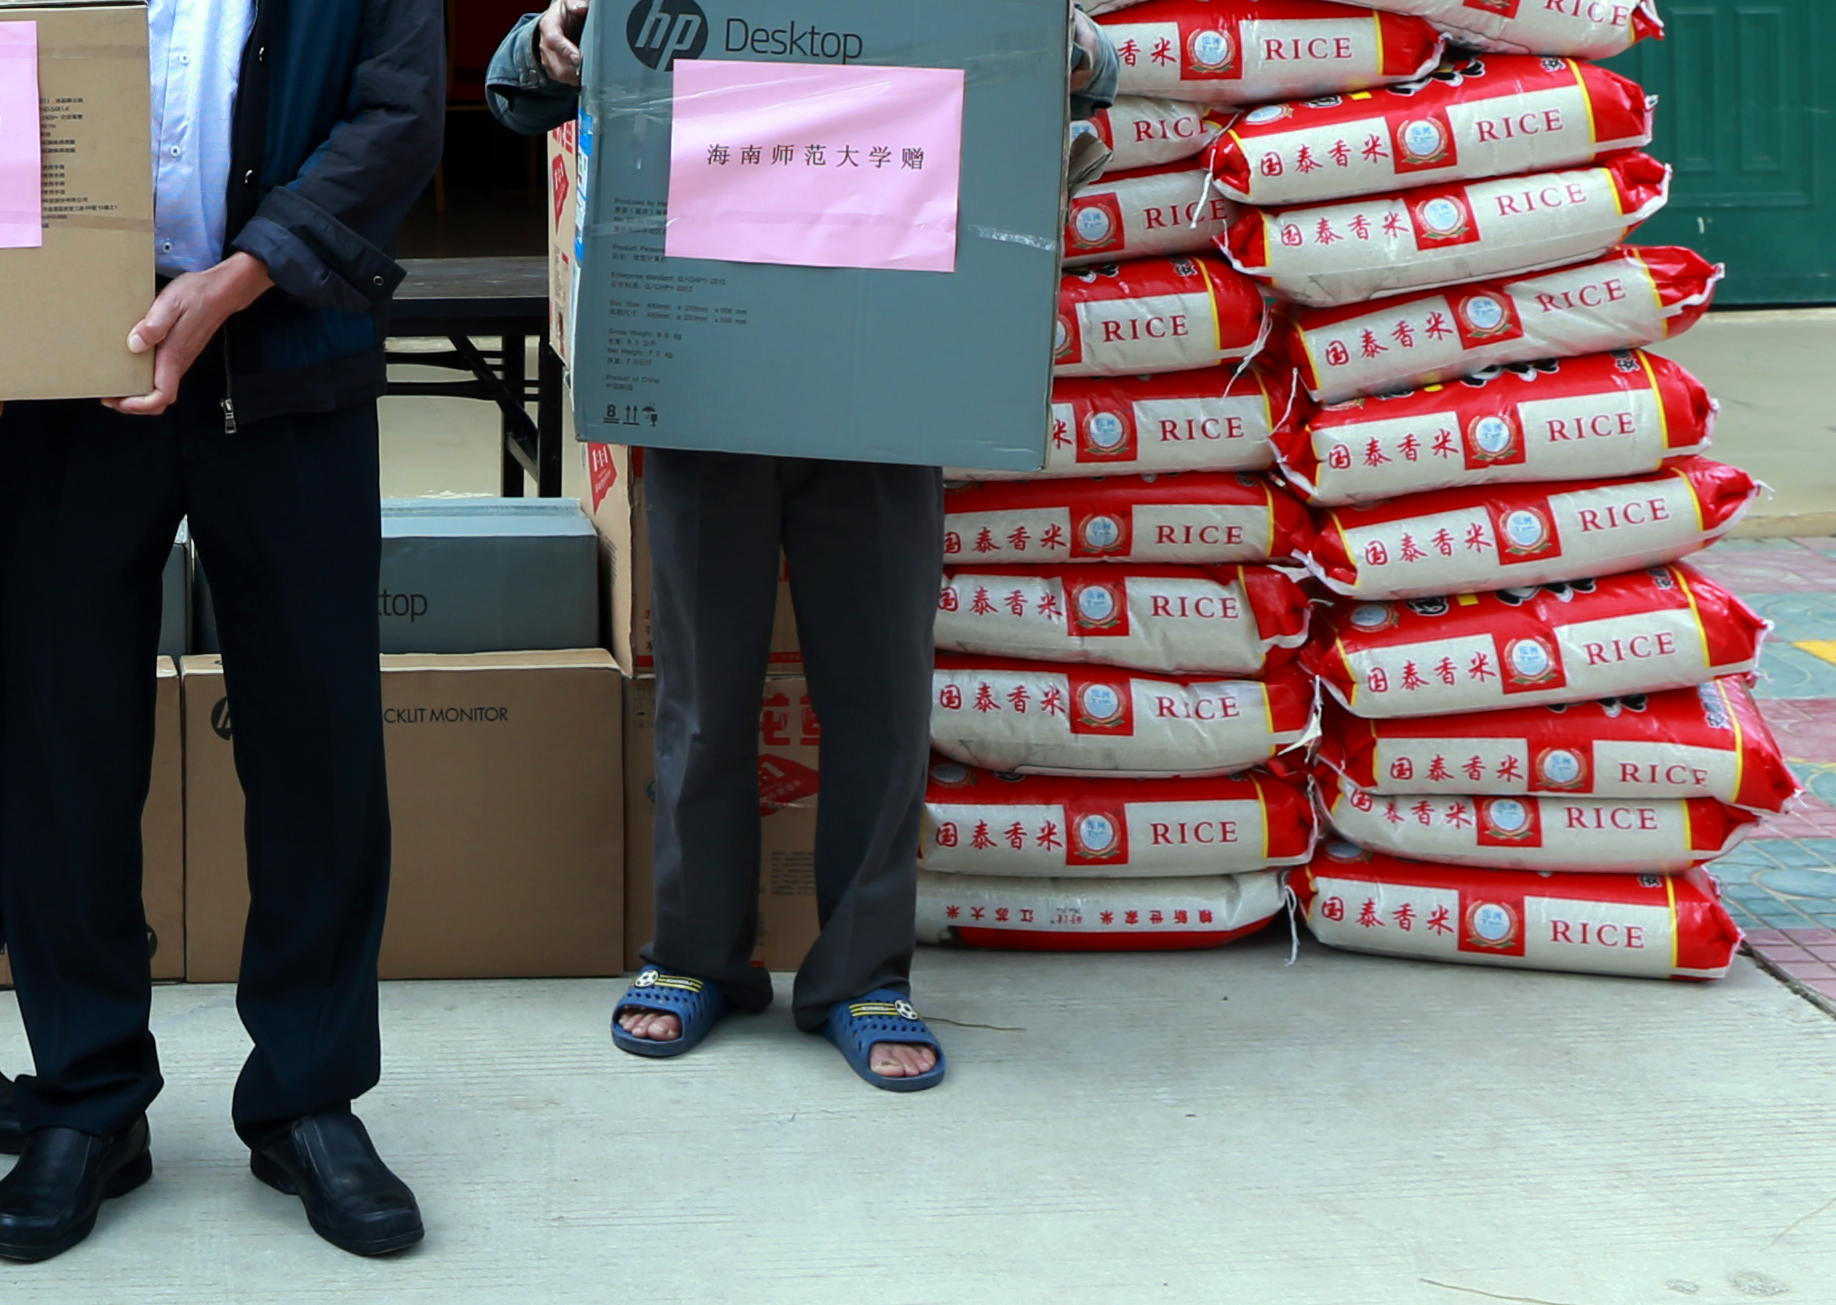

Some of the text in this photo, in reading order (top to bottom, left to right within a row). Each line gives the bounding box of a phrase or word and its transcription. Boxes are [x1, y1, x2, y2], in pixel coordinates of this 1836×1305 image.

[725, 17, 863, 64] Desktop
[1117, 36, 1177, 66] 香米
[1264, 36, 1354, 62] RICE
[1477, 107, 1564, 142] RICE
[707, 143, 925, 172] 海南师范大学赠
[1260, 132, 1390, 177] 国泰香米
[1144, 196, 1227, 230] RICE
[1497, 182, 1587, 217] RICE
[1279, 210, 1410, 247] 国泰香米
[1536, 276, 1627, 313] RICE
[1101, 313, 1189, 343] RICE
[1324, 309, 1455, 367] 国泰香米
[1159, 416, 1245, 443] RICE
[1547, 412, 1637, 442] RICE
[1328, 428, 1460, 471] 国泰香米
[1578, 499, 1671, 532] RICE
[944, 523, 1068, 555] 国泰香米
[1155, 525, 1244, 545] RICE
[1365, 523, 1495, 566] 国泰香米
[938, 586, 1064, 620] 国泰香米
[1150, 595, 1240, 620] RICE
[1585, 632, 1677, 665] RICE
[1367, 651, 1498, 694] 国泰香米
[939, 682, 1066, 714] 国泰香米
[1156, 696, 1240, 721] RICE
[384, 706, 508, 723] CKLIT MONITOR
[1390, 753, 1525, 783] 国泰香米
[1151, 822, 1238, 846] RICE
[1566, 806, 1659, 831] RICE
[936, 820, 1065, 852] 国泰香米
[1321, 896, 1457, 936] 国泰香米
[1550, 919, 1644, 950] RICE
